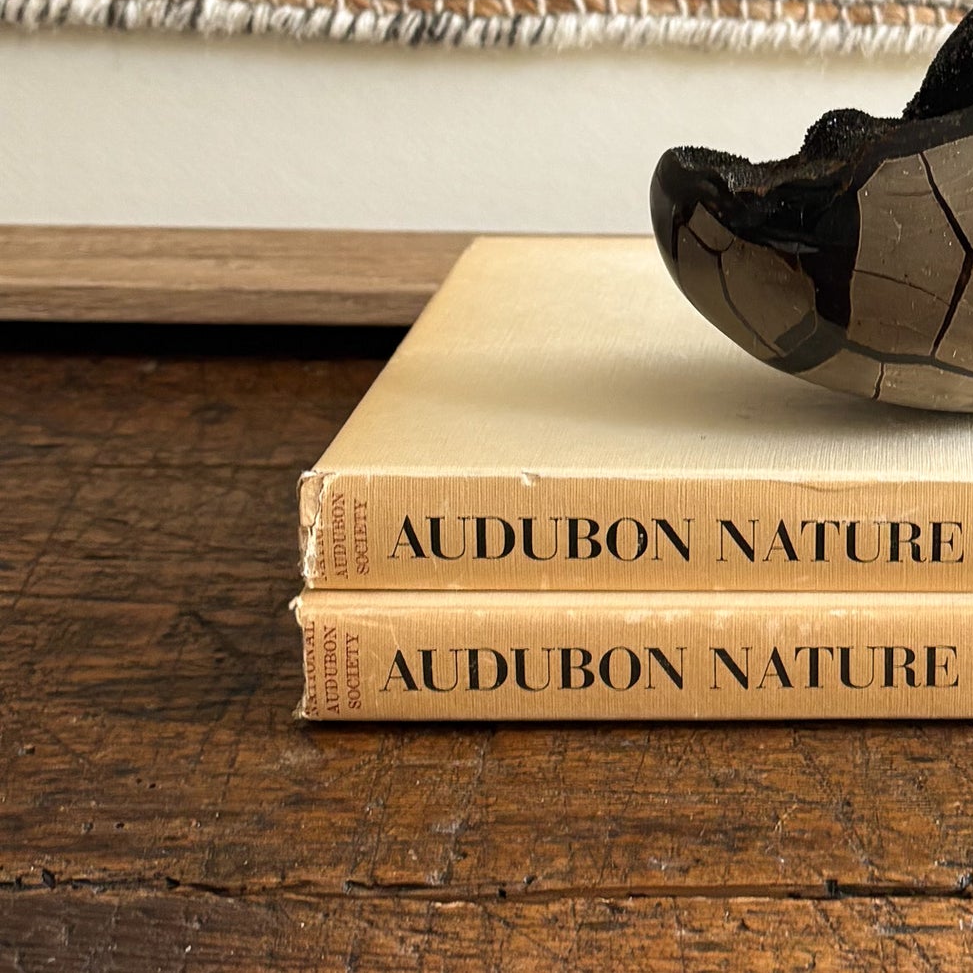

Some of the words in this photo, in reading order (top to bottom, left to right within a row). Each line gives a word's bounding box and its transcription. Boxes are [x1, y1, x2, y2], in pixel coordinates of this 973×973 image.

[332, 491, 349, 580] AUDUBON
[353, 499, 370, 576] SOCIETY
[386, 514, 696, 563] AUDUBON
[716, 518, 965, 563] NATURE
[323, 625, 341, 715] AUDUBON
[345, 632, 362, 710] SOCIETY
[378, 646, 688, 692] AUDUBON
[709, 645, 960, 690] NATURE
